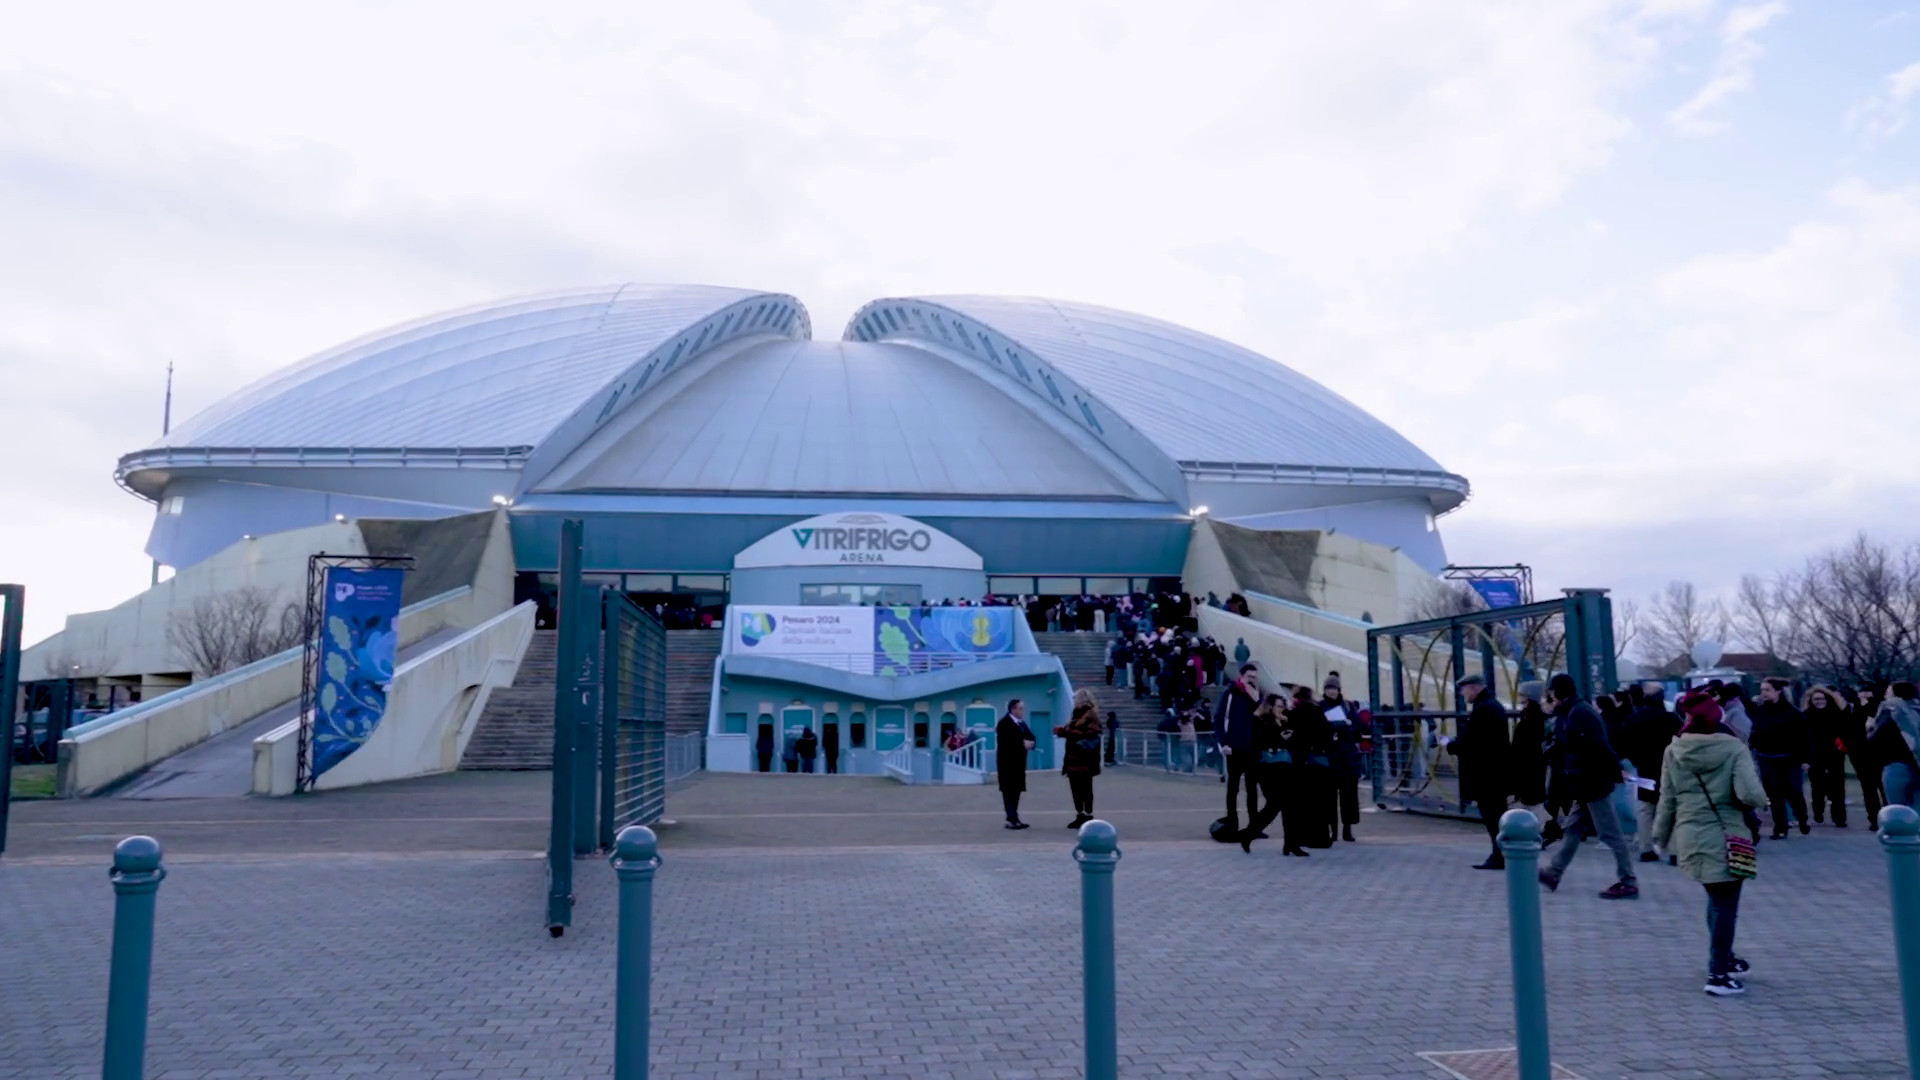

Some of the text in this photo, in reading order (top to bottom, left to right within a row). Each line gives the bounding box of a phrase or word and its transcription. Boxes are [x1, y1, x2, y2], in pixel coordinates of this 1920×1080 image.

[792, 528, 931, 551] VITRIFRIGO
[840, 553, 884, 562] ARENA
[816, 616, 840, 624] 2024
